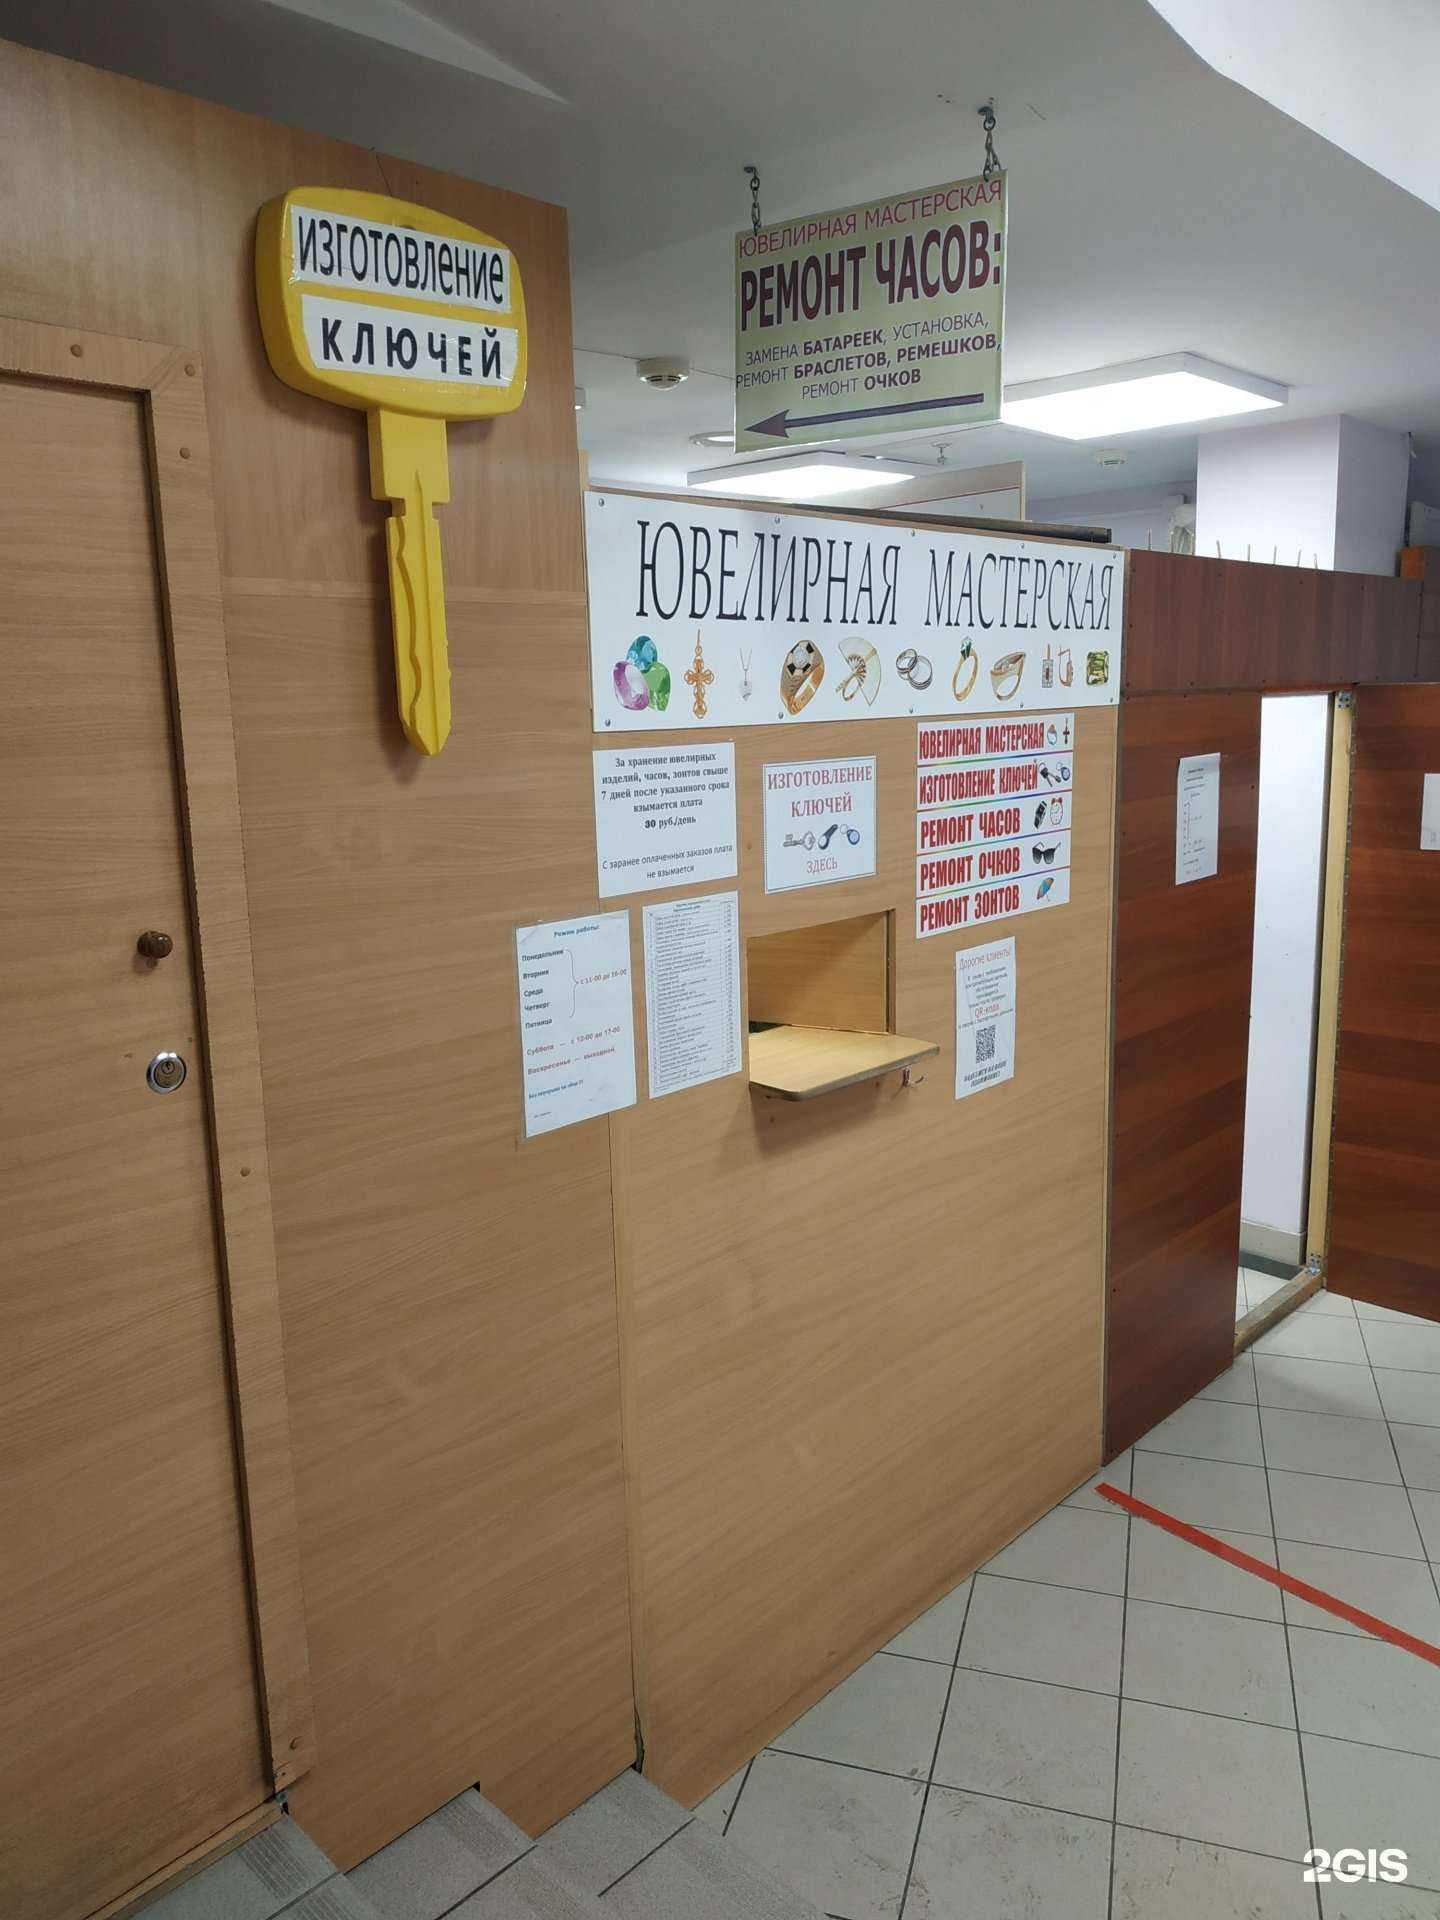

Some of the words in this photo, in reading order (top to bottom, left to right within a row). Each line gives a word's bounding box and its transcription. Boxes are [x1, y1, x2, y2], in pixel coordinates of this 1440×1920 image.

[739, 213, 856, 258] ЮВЕЛИРНАЯ
[865, 180, 1002, 230] МАСТЕРСКАЯ
[741, 246, 866, 332] РЕМОНТ
[876, 220, 1001, 304] ЧАСОВ:
[321, 318, 501, 379] КЛЮЧЕЙ
[746, 344, 798, 366] ЗАМЕНА
[803, 329, 887, 355] БАТАРЕЕК,
[893, 311, 989, 340] УСТАНОВКА,
[736, 367, 789, 388] РЕМОНТ
[794, 351, 891, 379] БРАСЛЕТОВ,
[897, 333, 1001, 362] РЕМЕШКОВ,
[802, 378, 858, 400] РЕМОНТ
[864, 368, 921, 391] ОЧКОВ
[636, 519, 901, 625] ЮВЕЛИРНАЯ
[924, 548, 1114, 631] МАСТЕРСКАЯ
[919, 727, 981, 759] ЮВЕЛИРНАЯ
[986, 722, 1045, 753] МАСТЕРСКАЯ
[602, 771, 642, 784] изделий,
[644, 771, 670, 781] часов,
[672, 769, 700, 779] зонтов
[703, 767, 729, 776] свыше
[615, 758, 625, 767] За
[628, 755, 667, 767] хранение
[669, 752, 717, 765] ювелирных
[768, 766, 872, 790] ИЗГОТОВЛЕНИЕ
[601, 791, 607, 800] 7
[610, 788, 631, 800] дней
[634, 786, 657, 797] после
[661, 783, 706, 796] указанного
[708, 780, 730, 792] срока
[919, 768, 995, 804] ИЗГОТОВЛЕНИЕ
[1000, 759, 1038, 793] КЛЮЧЕЙ
[680, 798, 703, 809] плата
[792, 792, 852, 818] КЛЮЧЕЙ
[645, 819, 656, 828] 30
[921, 814, 973, 848] РЕМОНТ
[979, 807, 1020, 838] ЧАСОВ
[647, 870, 655, 879] не
[807, 857, 838, 874] ЗДЕСЬ
[920, 855, 973, 891] РЕМОНТ
[979, 846, 1020, 879] ОЧКОВ
[920, 896, 969, 932] РЕМОНТ
[975, 884, 1019, 919] ЗОНТОВ
